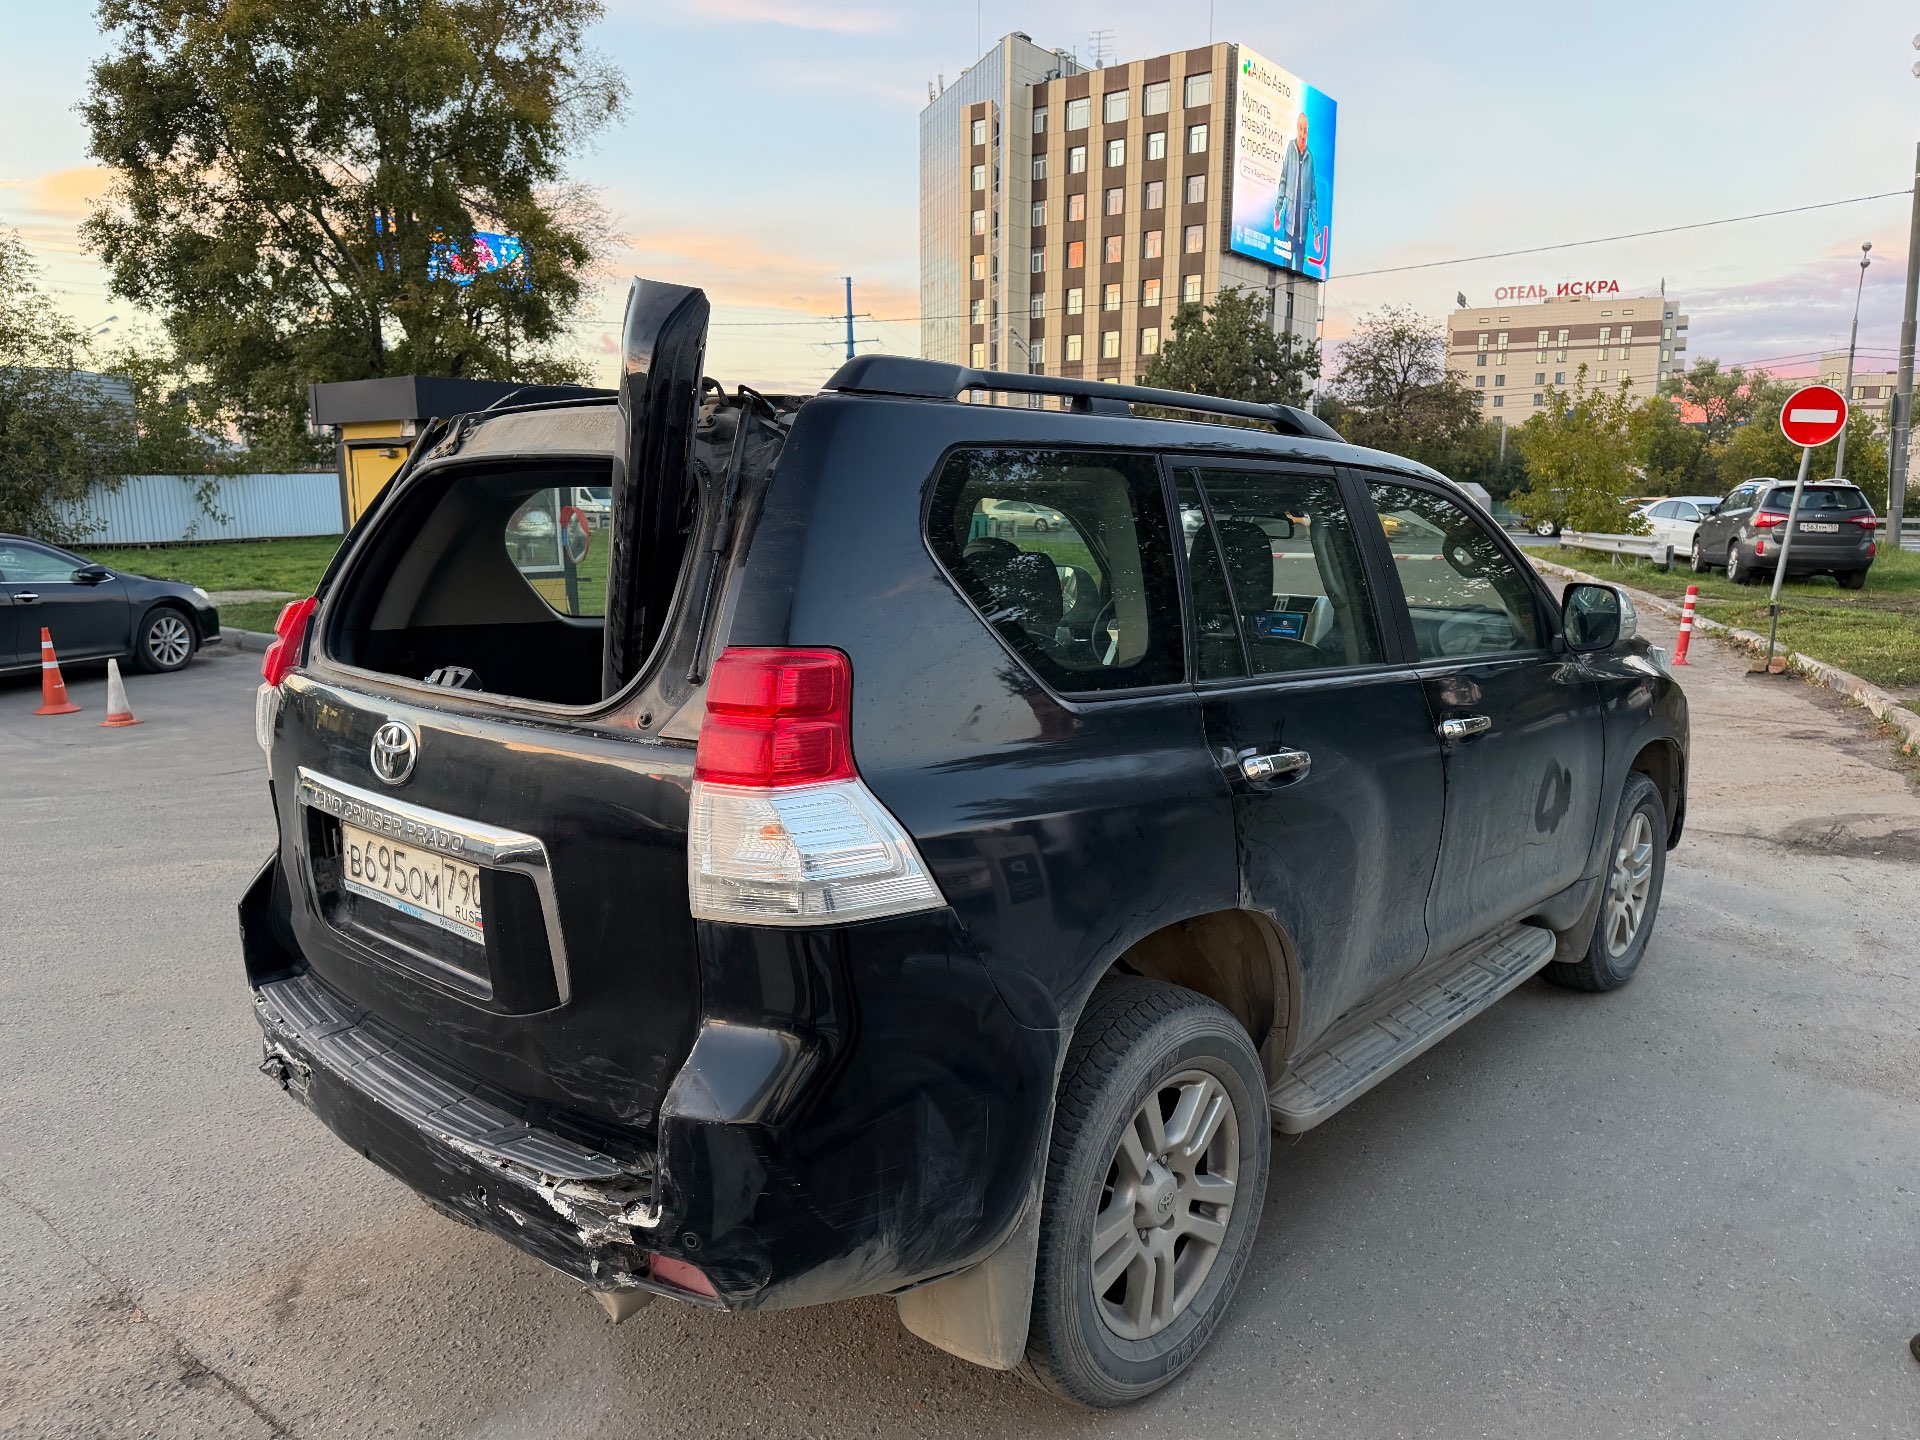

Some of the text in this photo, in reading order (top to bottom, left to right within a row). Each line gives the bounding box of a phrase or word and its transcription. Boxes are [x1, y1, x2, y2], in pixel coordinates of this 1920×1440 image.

[1251, 62, 1291, 98] Avito Авто
[1242, 90, 1271, 120] Купить
[1240, 135, 1246, 148] с
[1241, 114, 1283, 147] новый или
[1494, 279, 1620, 301] ОТЕЛЬ ИСКРА
[313, 787, 465, 854] LAND CRUISER PRADO
[455, 905, 475, 923] RUS
[1166, 1304, 1216, 1373] AT20
